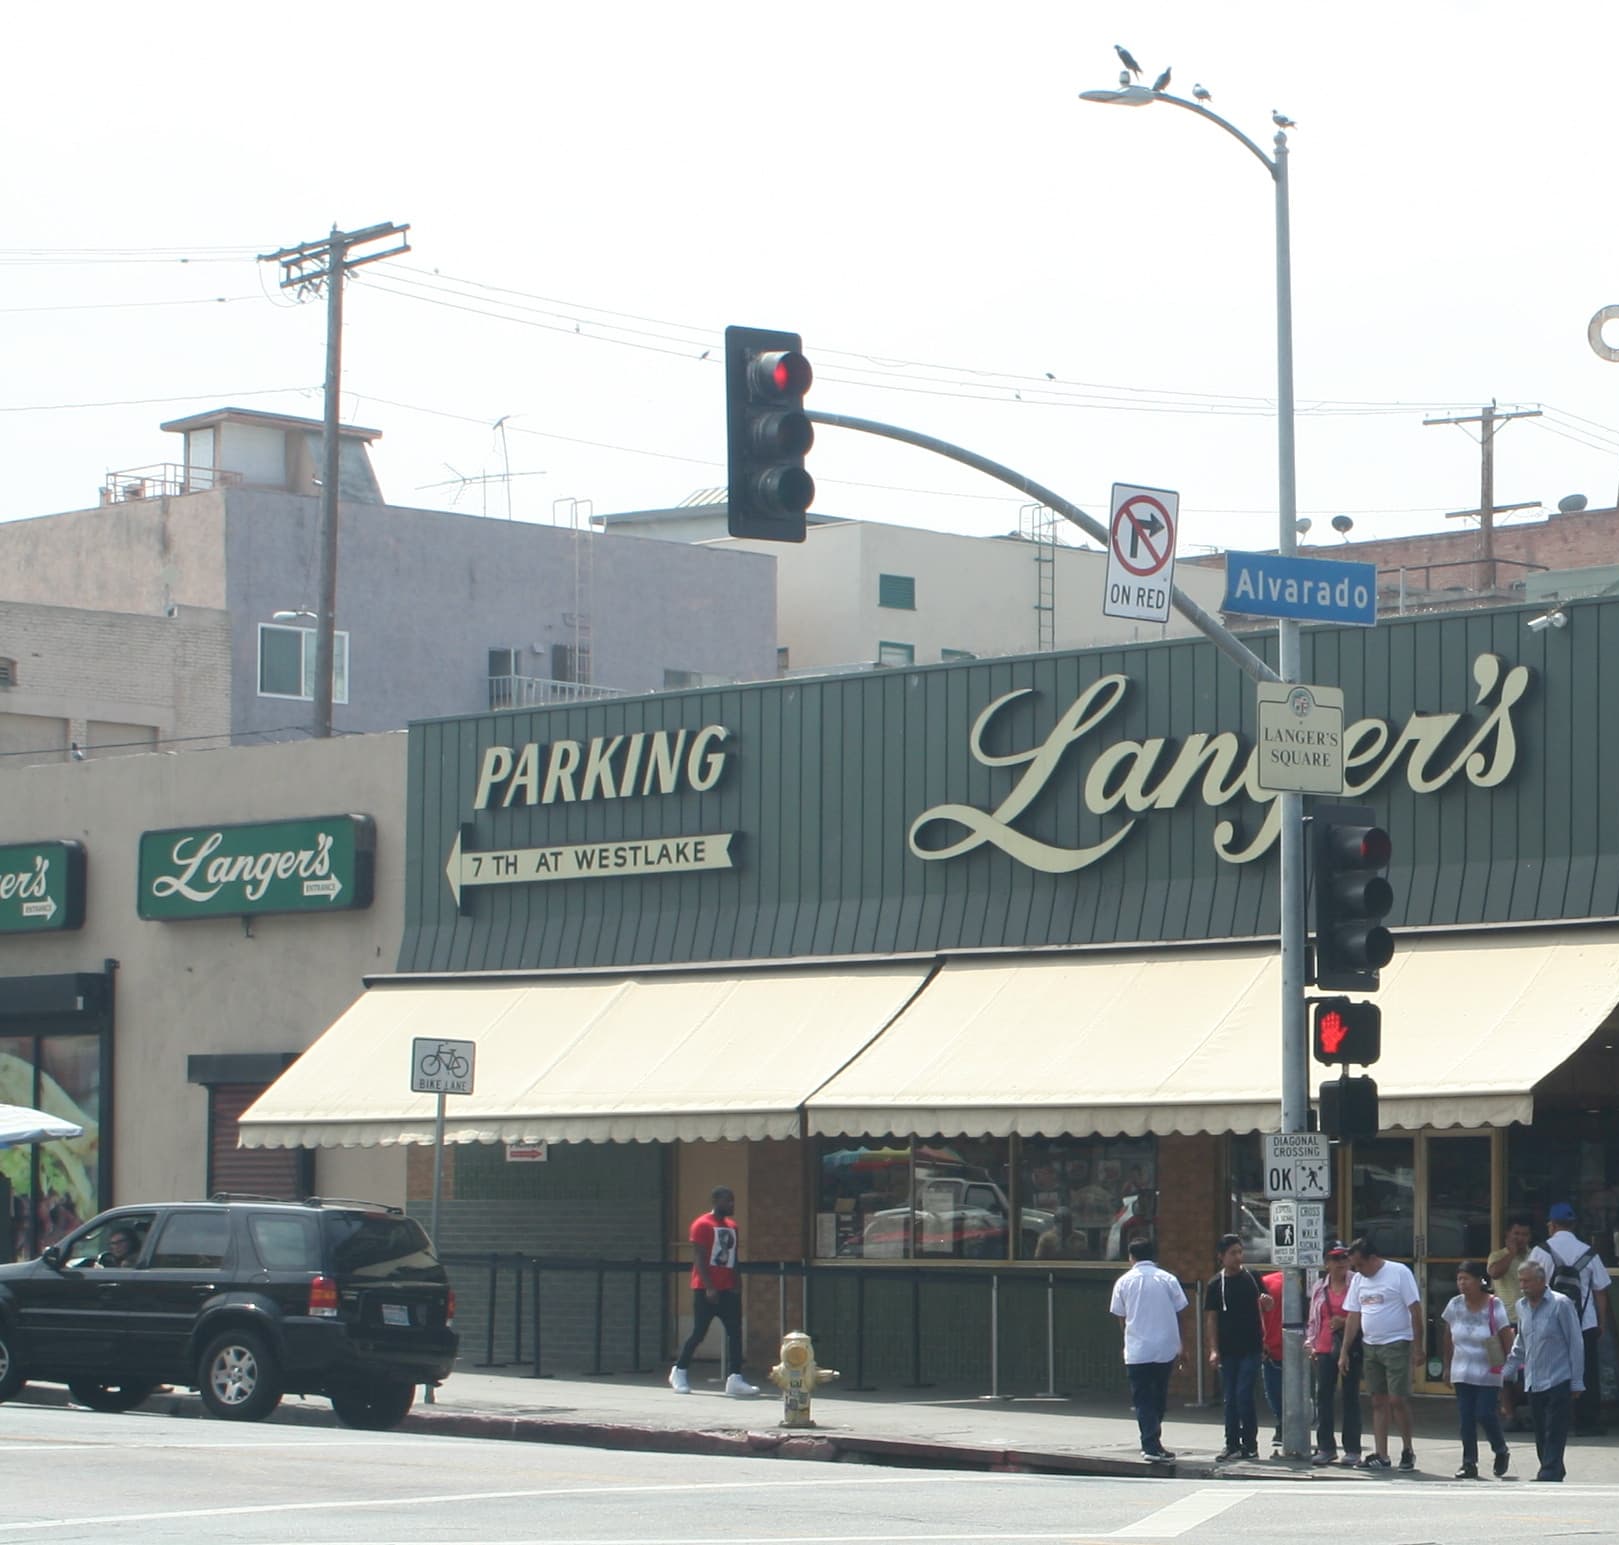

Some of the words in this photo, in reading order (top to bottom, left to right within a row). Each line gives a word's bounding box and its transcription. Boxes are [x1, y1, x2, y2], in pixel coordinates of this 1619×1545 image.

[1110, 583, 1131, 605] ON
[1136, 587, 1166, 609] RED
[1234, 568, 1368, 609] Alvarado
[1264, 727, 1338, 747] LANGER'S
[474, 725, 730, 810] PARKING
[1271, 749, 1331, 767] SQUARE
[153, 833, 333, 902] Langer's
[472, 857, 482, 877] 7
[492, 855, 518, 876] TH
[536, 852, 563, 873] AT
[575, 841, 705, 870] WESTLAKE
[0, 855, 49, 899] er's
[420, 1079, 441, 1090] BIKE
[443, 1080, 467, 1091] LANE
[1273, 1136, 1319, 1146] DIAGONAL
[1273, 1147, 1320, 1158] CROSSING
[1269, 1168, 1292, 1191] OK
